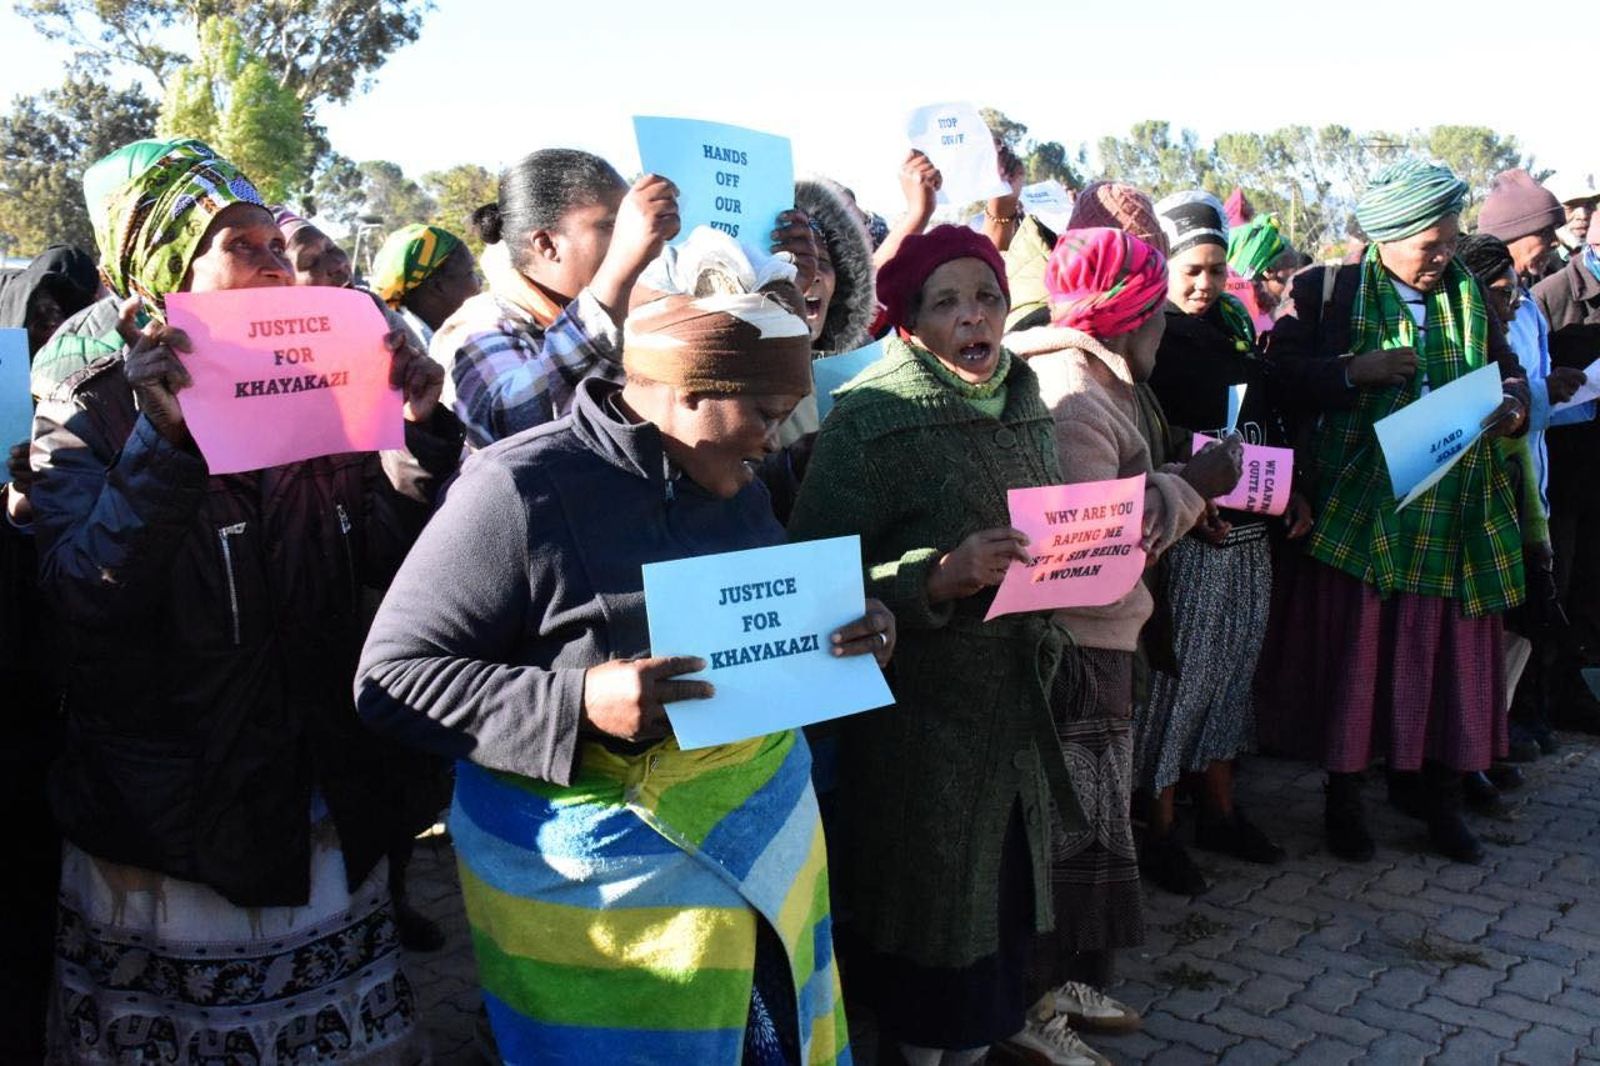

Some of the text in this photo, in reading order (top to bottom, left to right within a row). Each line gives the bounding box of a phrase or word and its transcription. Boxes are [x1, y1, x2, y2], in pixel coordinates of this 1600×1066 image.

[703, 145, 748, 166] HANDS
[716, 171, 740, 188] OFF
[715, 196, 742, 214] OUR
[248, 316, 331, 338] JUSTICE
[274, 347, 314, 366] FOR
[235, 371, 348, 398] KHAYAKAZI
[1248, 460, 1260, 493] QUITE
[1262, 461, 1276, 513] WE CANN
[1045, 501, 1134, 526] WHY ARE YOU
[1052, 526, 1124, 547] RAPING ME
[1054, 554, 1065, 564] A
[1066, 549, 1089, 562] SIN
[1089, 544, 1132, 557] BEING
[1035, 564, 1102, 583] A WOMAN
[719, 577, 797, 605] JUSTICE
[742, 611, 782, 633] FOR
[710, 633, 820, 670] KHAYAKAZI
